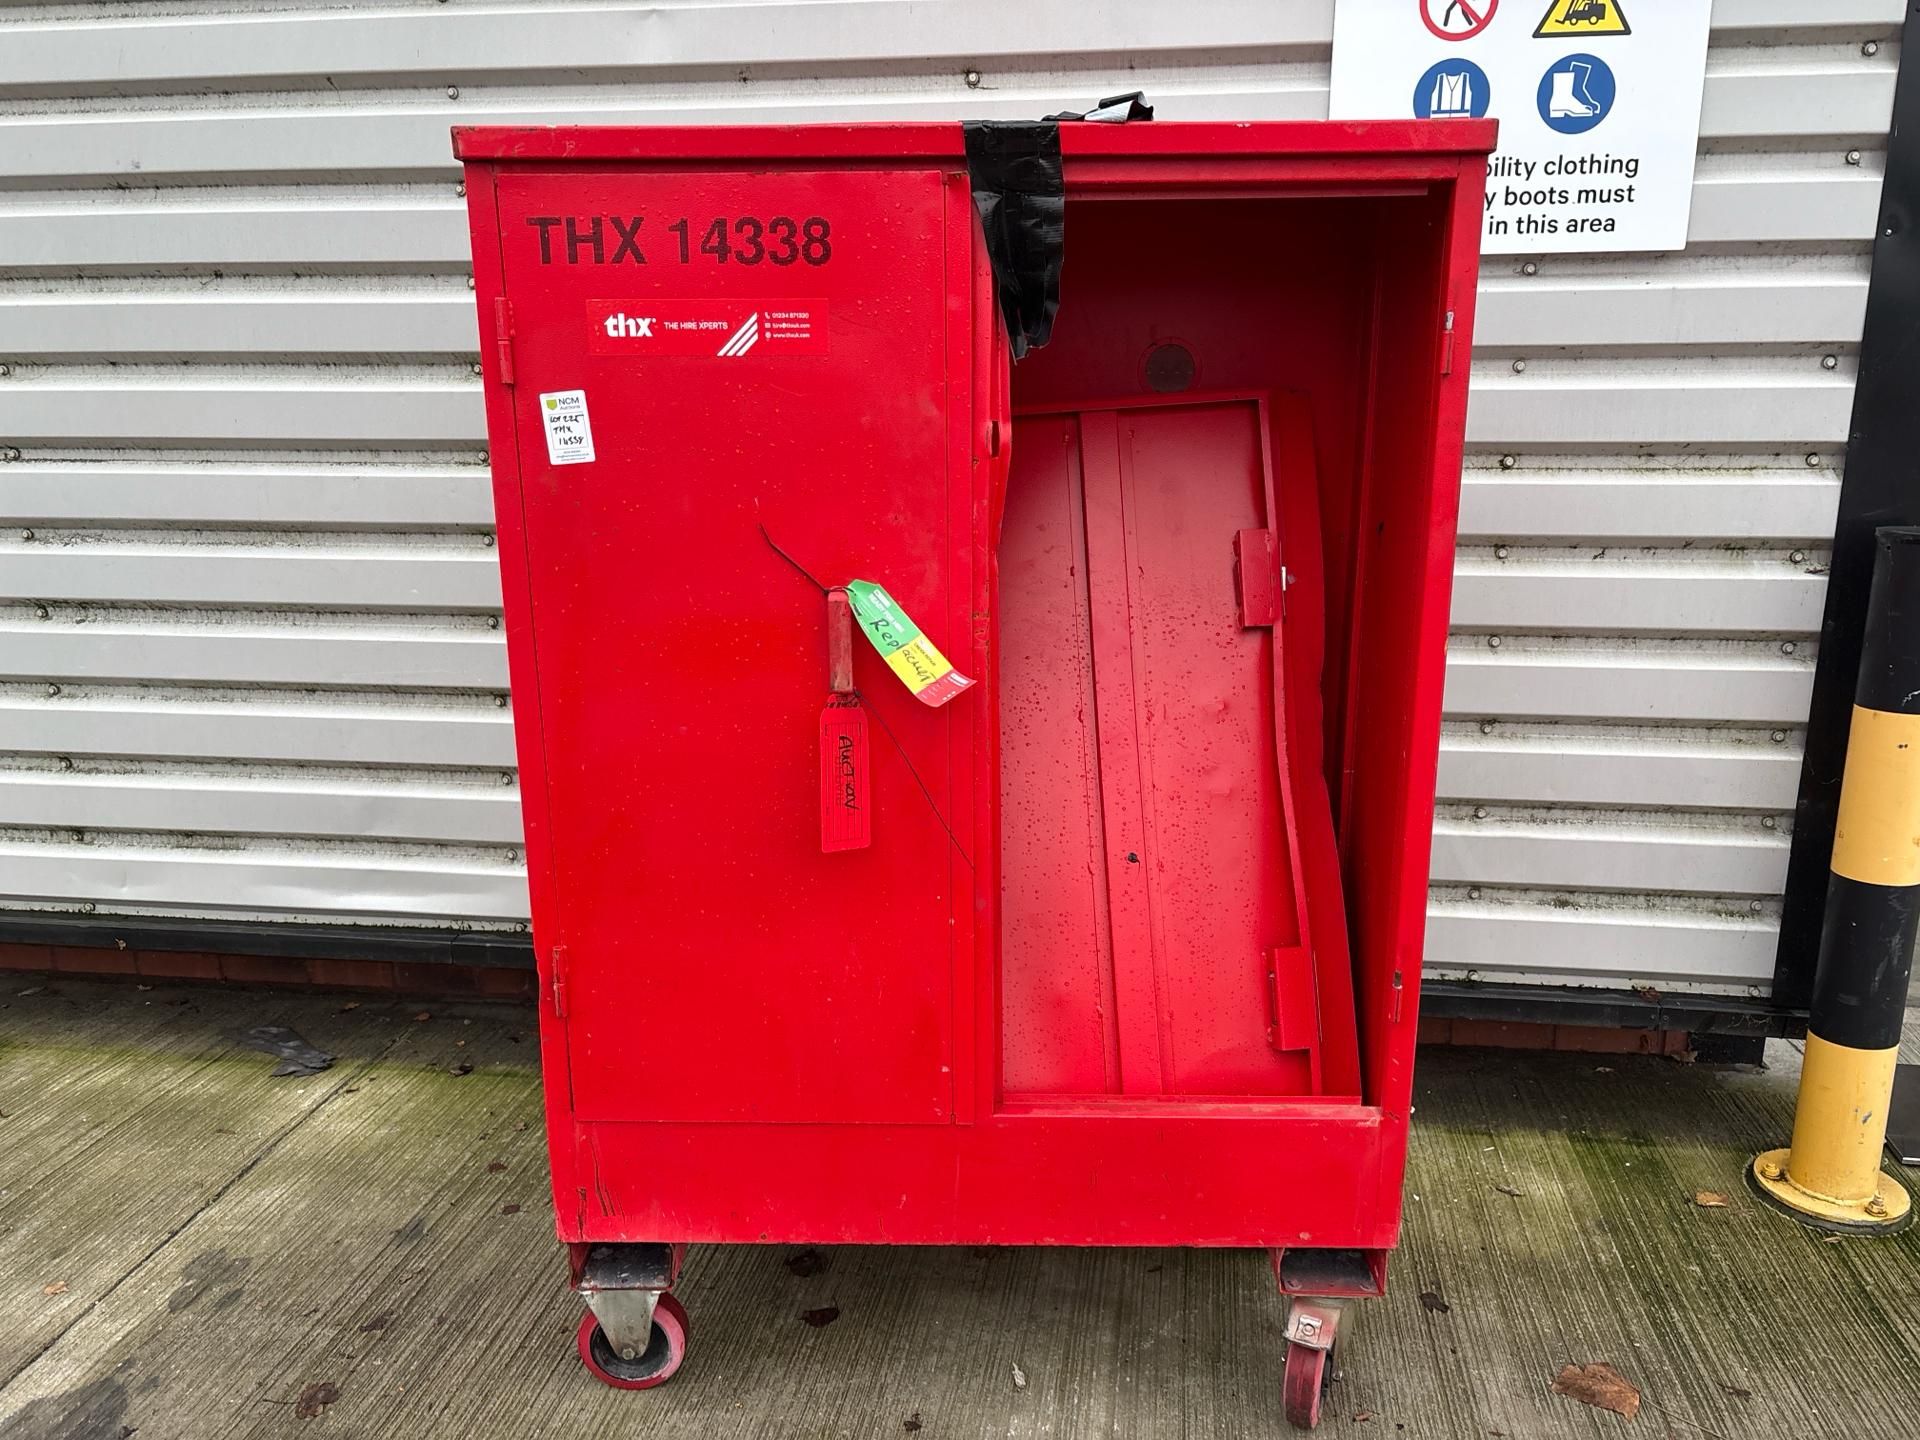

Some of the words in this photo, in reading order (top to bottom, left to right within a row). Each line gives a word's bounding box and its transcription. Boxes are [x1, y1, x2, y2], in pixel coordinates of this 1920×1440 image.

[1544, 153, 1640, 178] clothing
[1504, 185, 1570, 206] boots
[1577, 184, 1636, 204] must
[1489, 215, 1508, 235] in
[1516, 214, 1559, 235] this
[1566, 217, 1616, 233] area
[526, 216, 648, 265] THX
[668, 216, 832, 267] 14338
[604, 312, 653, 337] thx
[663, 321, 679, 330] THE
[680, 321, 698, 330] HIRE
[699, 321, 728, 330] XPERTS
[558, 396, 580, 405] NCM
